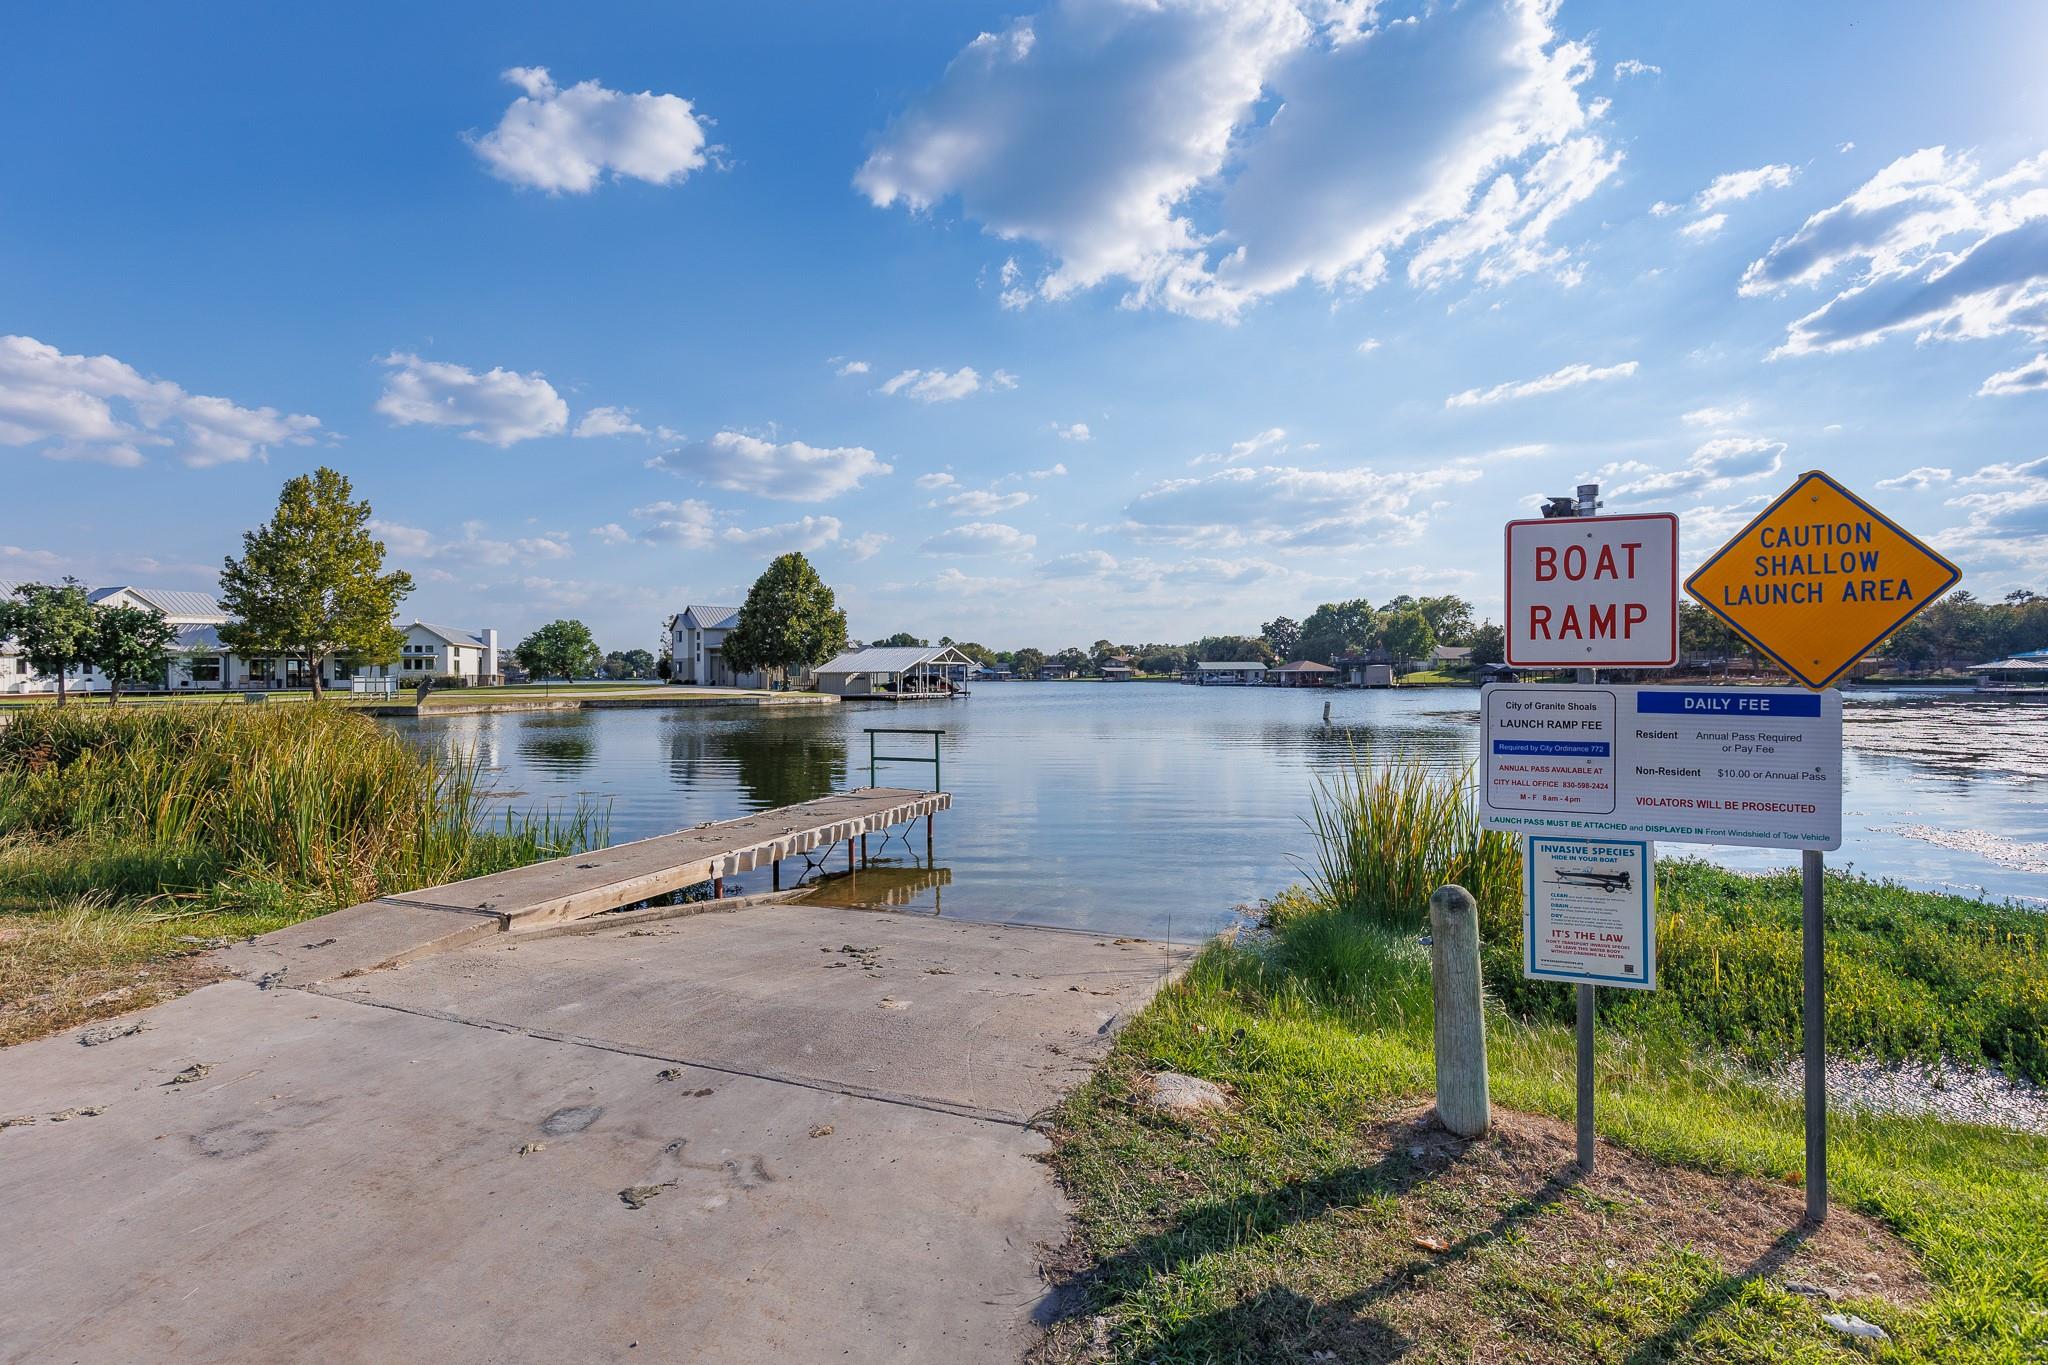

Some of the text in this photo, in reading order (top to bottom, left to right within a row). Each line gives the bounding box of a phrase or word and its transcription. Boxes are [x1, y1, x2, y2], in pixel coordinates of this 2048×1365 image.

[1761, 522, 1871, 548] CAUTION
[1536, 543, 1642, 581] BOAT
[1755, 551, 1880, 576] SHALLOW
[1724, 579, 1912, 606] LAUNCH AREA
[1531, 604, 1647, 640] RAMP
[1506, 702, 1521, 711] City
[1535, 702, 1565, 710] Granite
[1685, 698, 1770, 710] DAILY FEE
[1500, 720, 1602, 729] LAUNCH RAMP FEE
[1636, 730, 1801, 743] Resident Annual Pass Required
[1499, 744, 1528, 752] Required
[1540, 745, 1553, 753] City
[1735, 745, 1752, 754] Pay
[1756, 745, 1774, 754] Fee
[1636, 766, 1701, 776] Non-Resident
[1718, 769, 1750, 779] $10.00
[1765, 771, 1798, 780] Annual
[1802, 772, 1826, 781] Pass
[1636, 797, 1815, 813] VIOLATORS WILL BE PROSECUTED
[1490, 816, 1522, 825] LAUNCH
[1524, 818, 1544, 826] PASS
[1547, 819, 1567, 827] MUST
[1584, 822, 1627, 830] ATTACHED
[1646, 825, 1692, 834] DISPLAYED
[1706, 828, 1725, 836] Front
[1728, 829, 1770, 838] Windshield
[1783, 832, 1798, 840] Tow
[1801, 833, 1830, 841] Vehicle
[1541, 845, 1635, 856] INVASIVE SPECIES
[1574, 932, 1595, 940] THE
[1600, 933, 1623, 942] LAW
